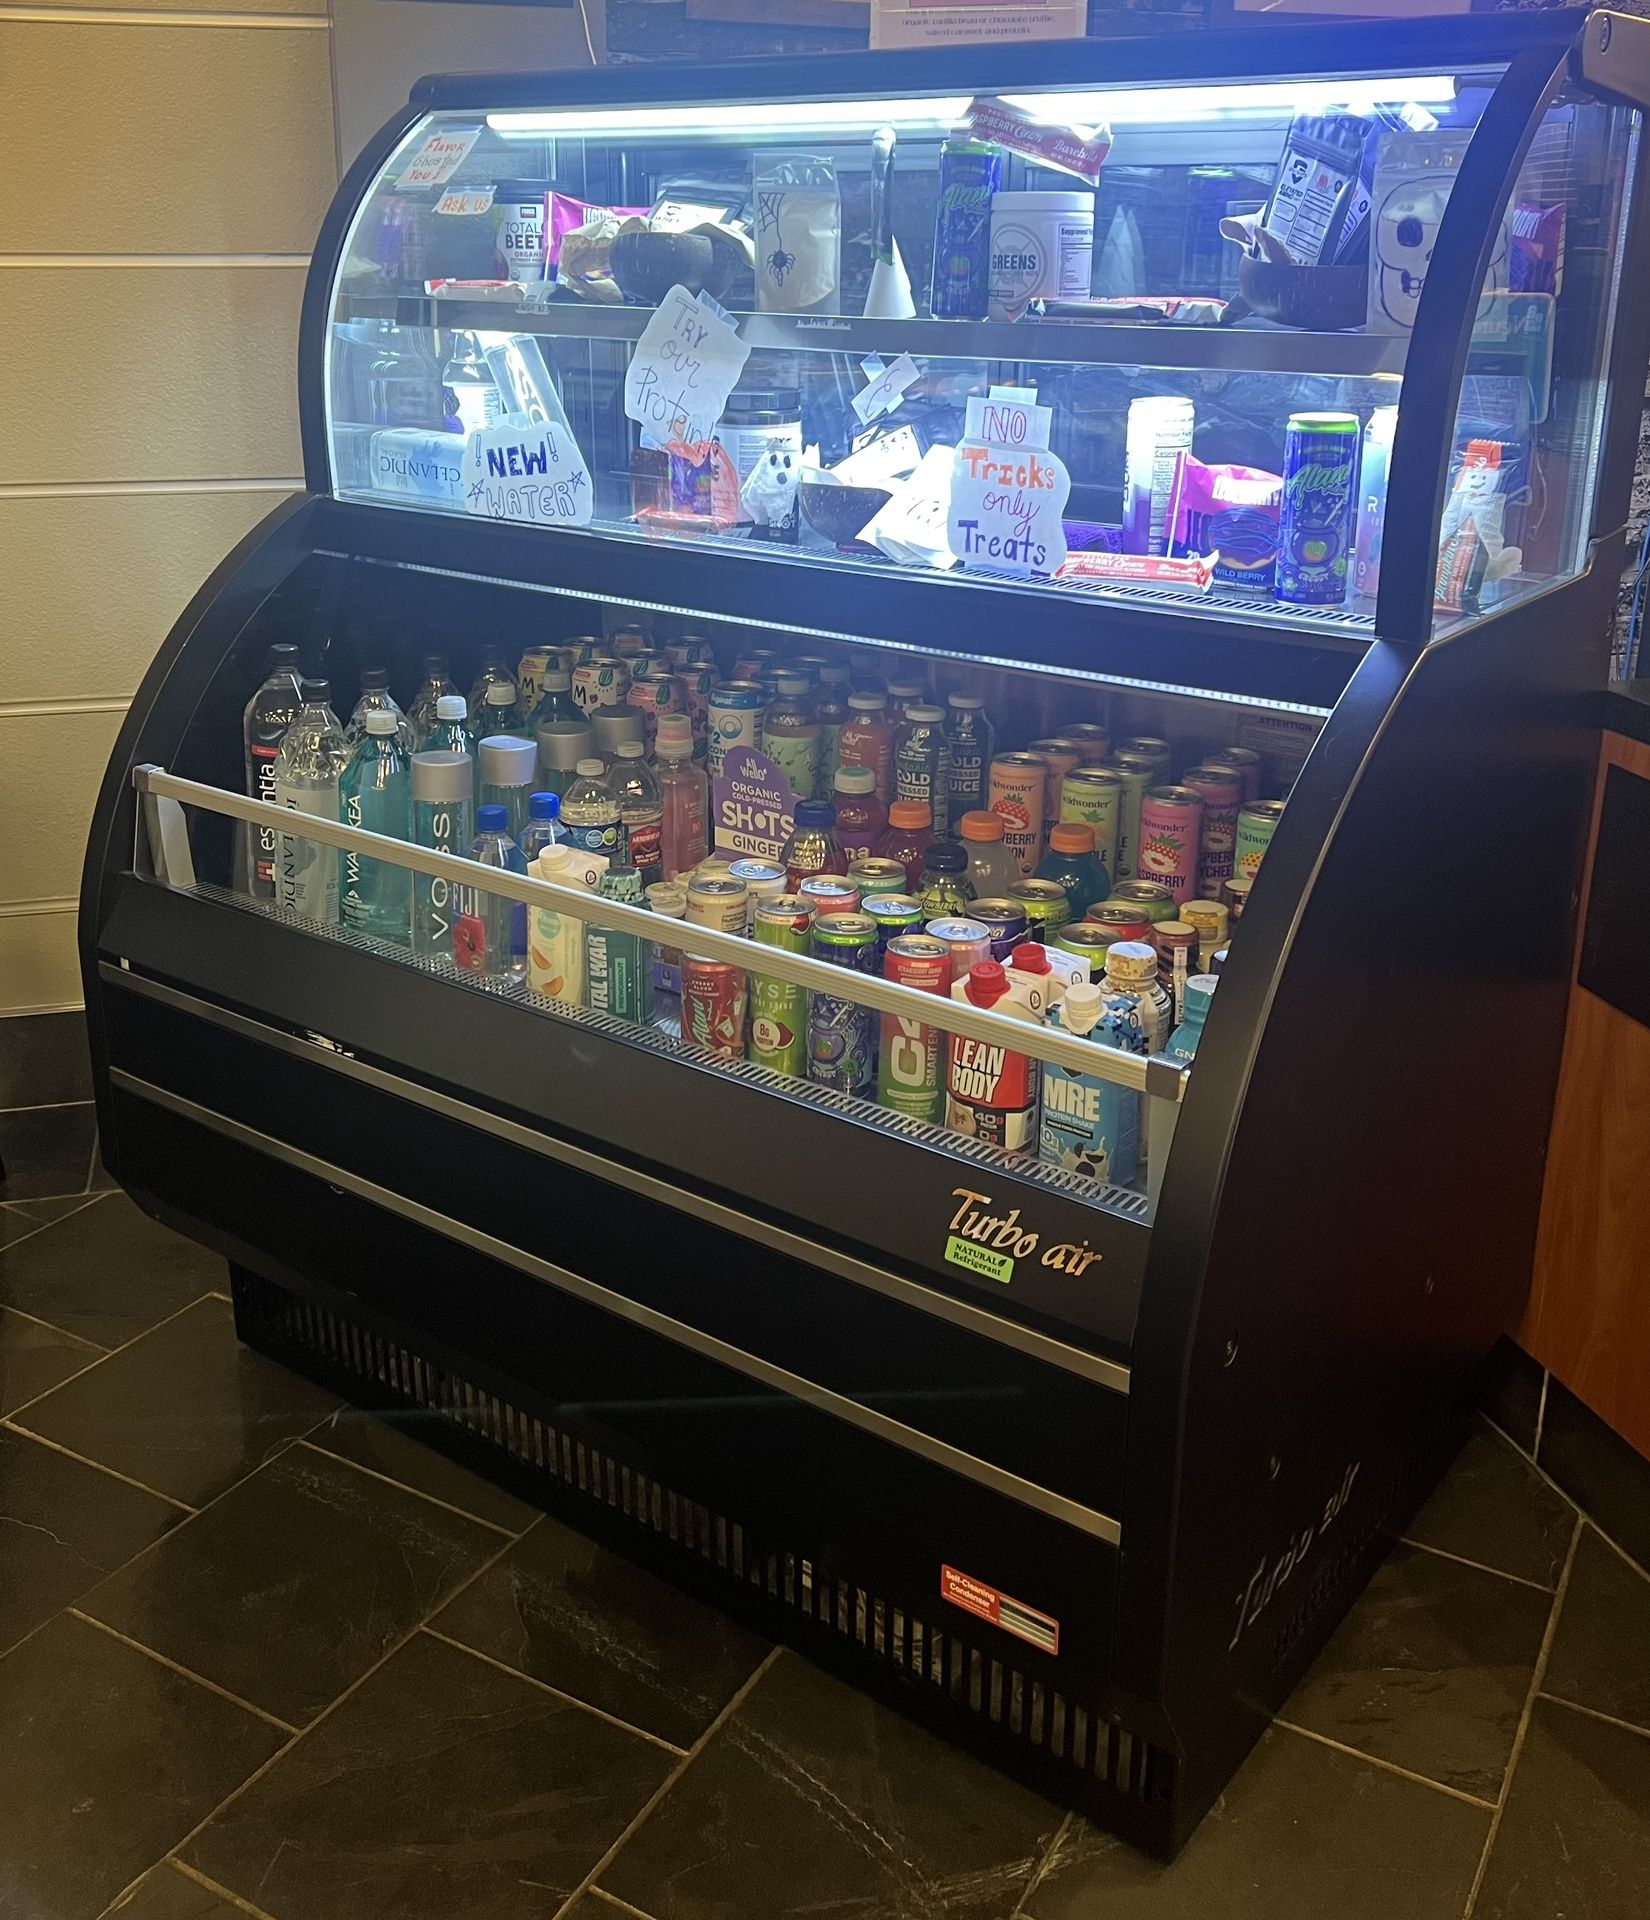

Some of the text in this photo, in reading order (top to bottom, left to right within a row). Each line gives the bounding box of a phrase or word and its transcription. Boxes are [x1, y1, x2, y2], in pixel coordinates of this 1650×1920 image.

[505, 222, 540, 234] TOTAL
[992, 254, 1036, 270] GREENS
[981, 405, 1028, 444] NO
[380, 456, 461, 483] CELANDIC
[486, 482, 576, 519] WATER
[982, 490, 1041, 537] only
[957, 519, 1047, 567] Treats
[1215, 567, 1266, 582] WILD BERRY
[1258, 716, 1313, 732] ATTENTION
[953, 757, 981, 768] OLD
[731, 781, 781, 802] ORGANIC
[950, 780, 980, 792] UICE
[257, 762, 275, 851] esntia
[721, 800, 795, 840] SHOTS
[347, 794, 362, 883] WAKEA
[587, 934, 607, 977] WAR
[754, 979, 797, 999] YSE
[926, 1045, 937, 1087] SMART
[953, 1037, 1006, 1076] LEAN
[951, 1066, 1000, 1103] BODY
[1044, 1073, 1100, 1122] MRE
[1072, 1115, 1095, 1129] SHAKE
[949, 1187, 1103, 1276] Turbo air
[953, 1251, 1002, 1277] Refrigerant
[955, 1243, 998, 1266] NATURAL
[945, 1570, 996, 1602] Self-Cleaning
[949, 1582, 991, 1608] Condenser
